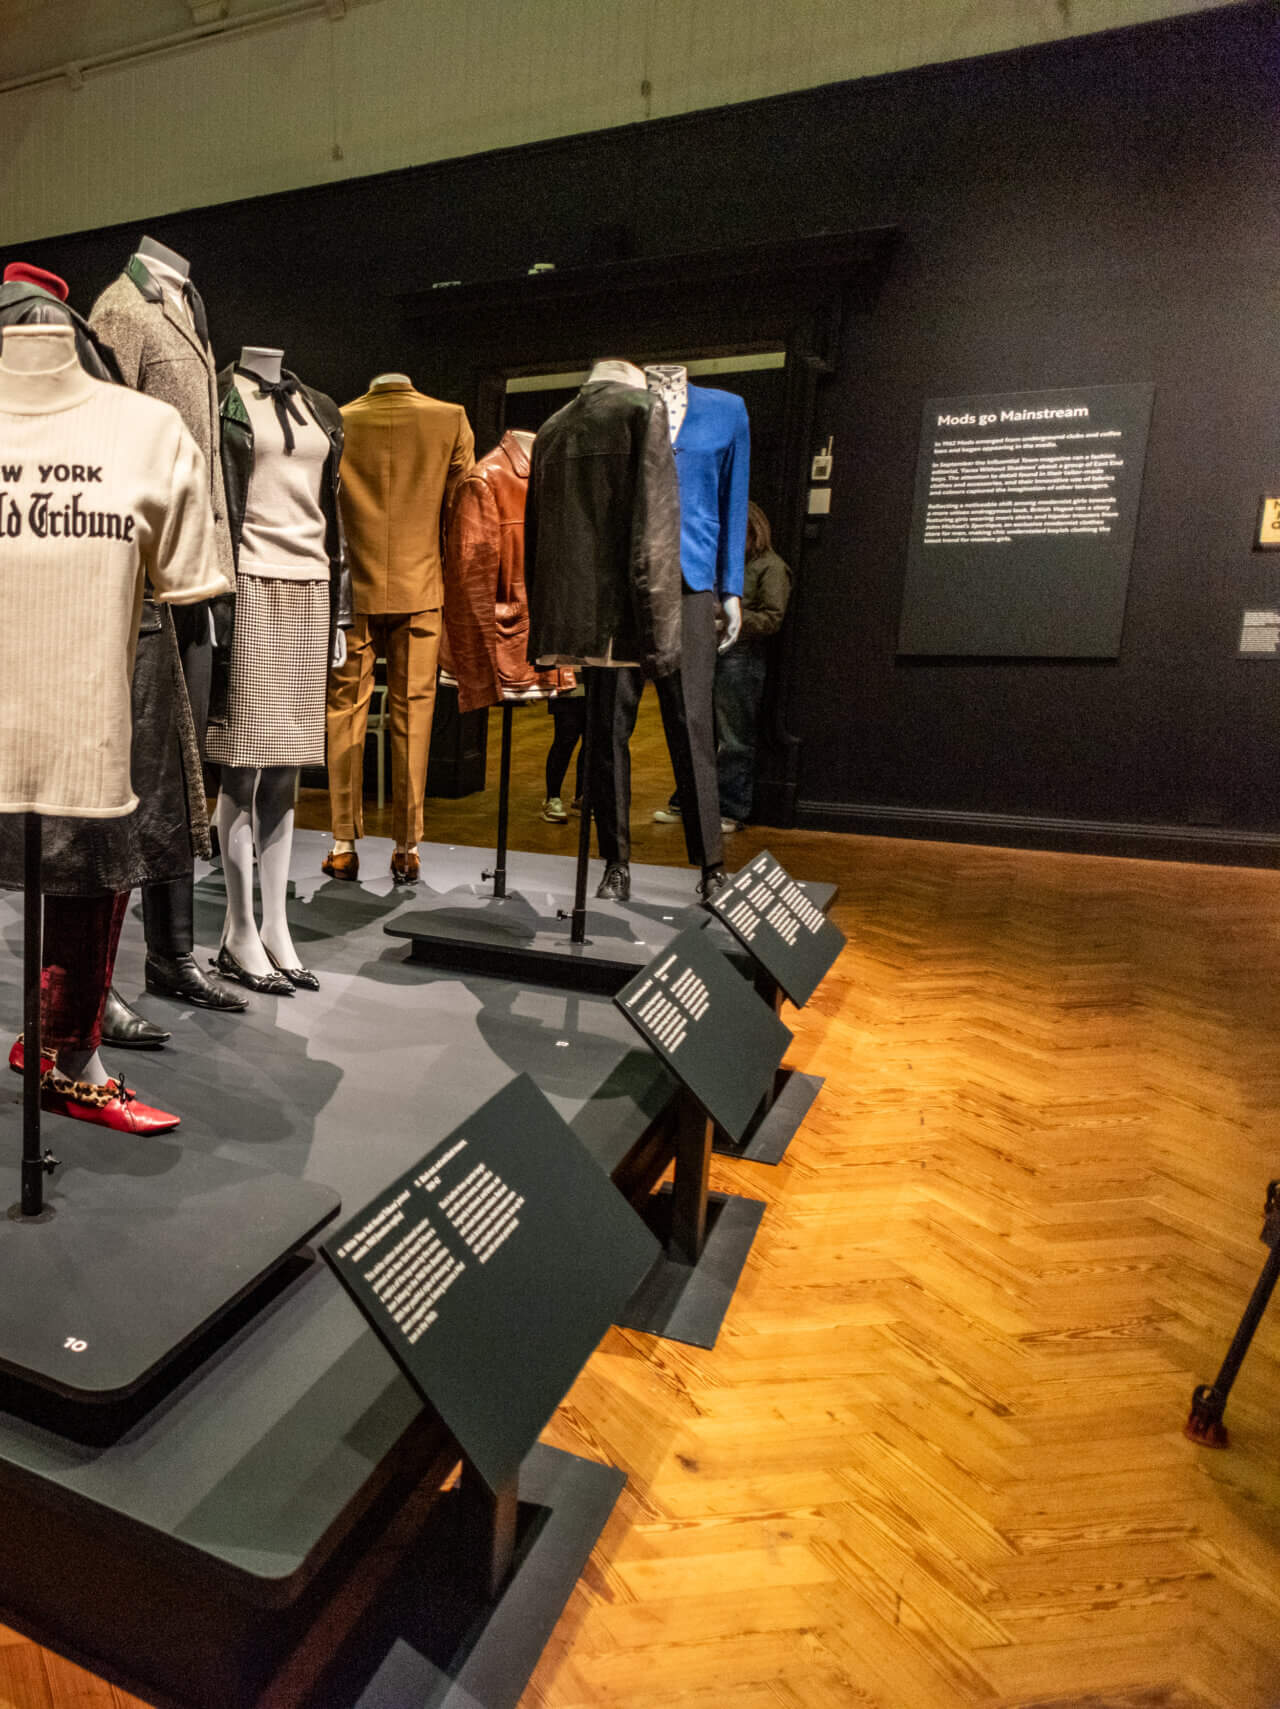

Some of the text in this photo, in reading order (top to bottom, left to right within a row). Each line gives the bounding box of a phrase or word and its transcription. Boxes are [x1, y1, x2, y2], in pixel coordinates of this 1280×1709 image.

[937, 407, 1089, 427] Mods go Mainstream
[38, 464, 103, 483] YORK
[28, 492, 136, 543] Tribune
[64, 1337, 88, 1352] 10
